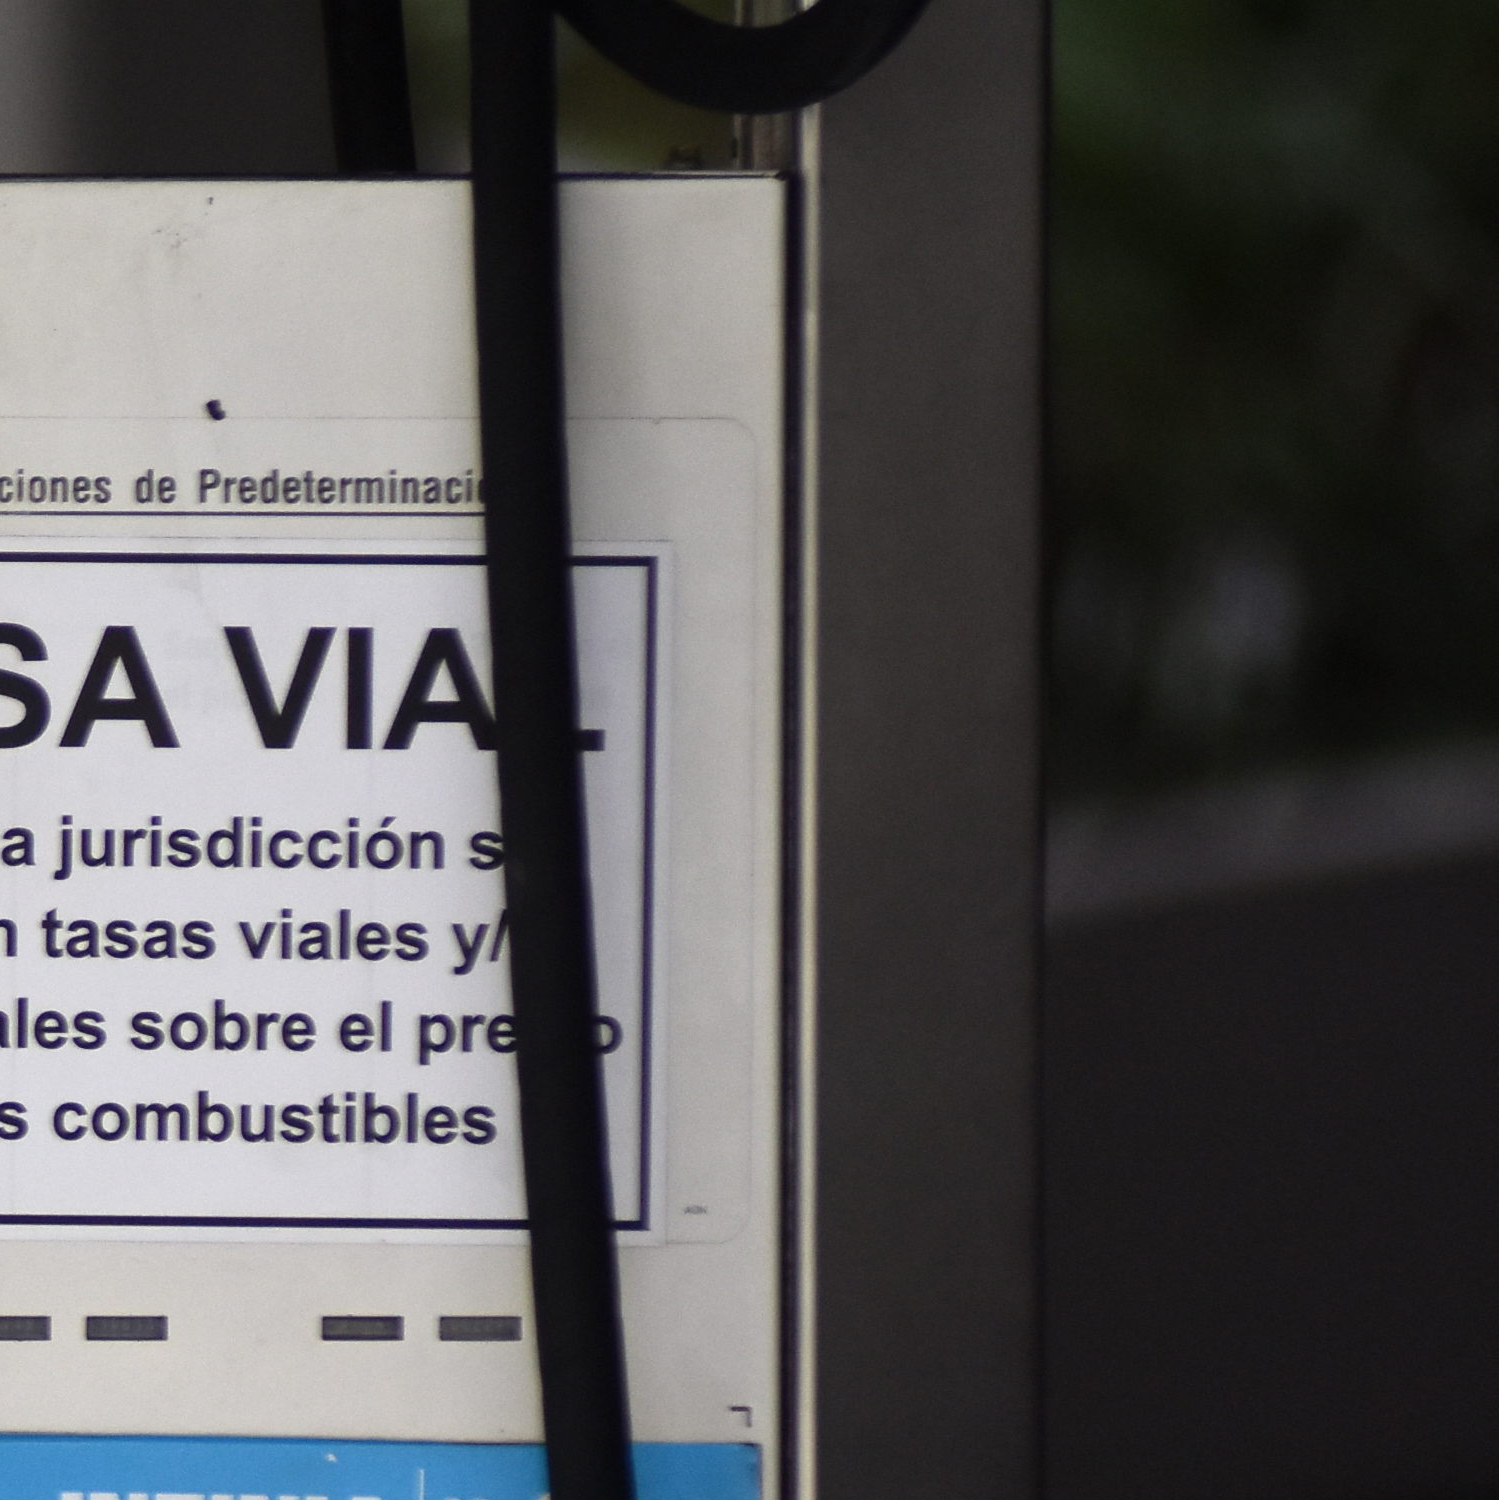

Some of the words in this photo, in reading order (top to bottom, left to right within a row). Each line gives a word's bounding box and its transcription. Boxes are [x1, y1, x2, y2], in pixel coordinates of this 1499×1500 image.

[134, 468, 178, 505] de
[198, 468, 485, 505] Predeterminaci
[223, 626, 606, 752] VIA
[53, 815, 446, 881] jurisdicción
[468, 828, 504, 871] s
[41, 907, 217, 960] tasas
[238, 907, 430, 962] viales
[452, 907, 510, 976] y/
[130, 998, 317, 1052] sobre
[339, 999, 393, 1053] el
[418, 1010, 624, 1067] preo
[52, 1089, 499, 1146] combustibles
